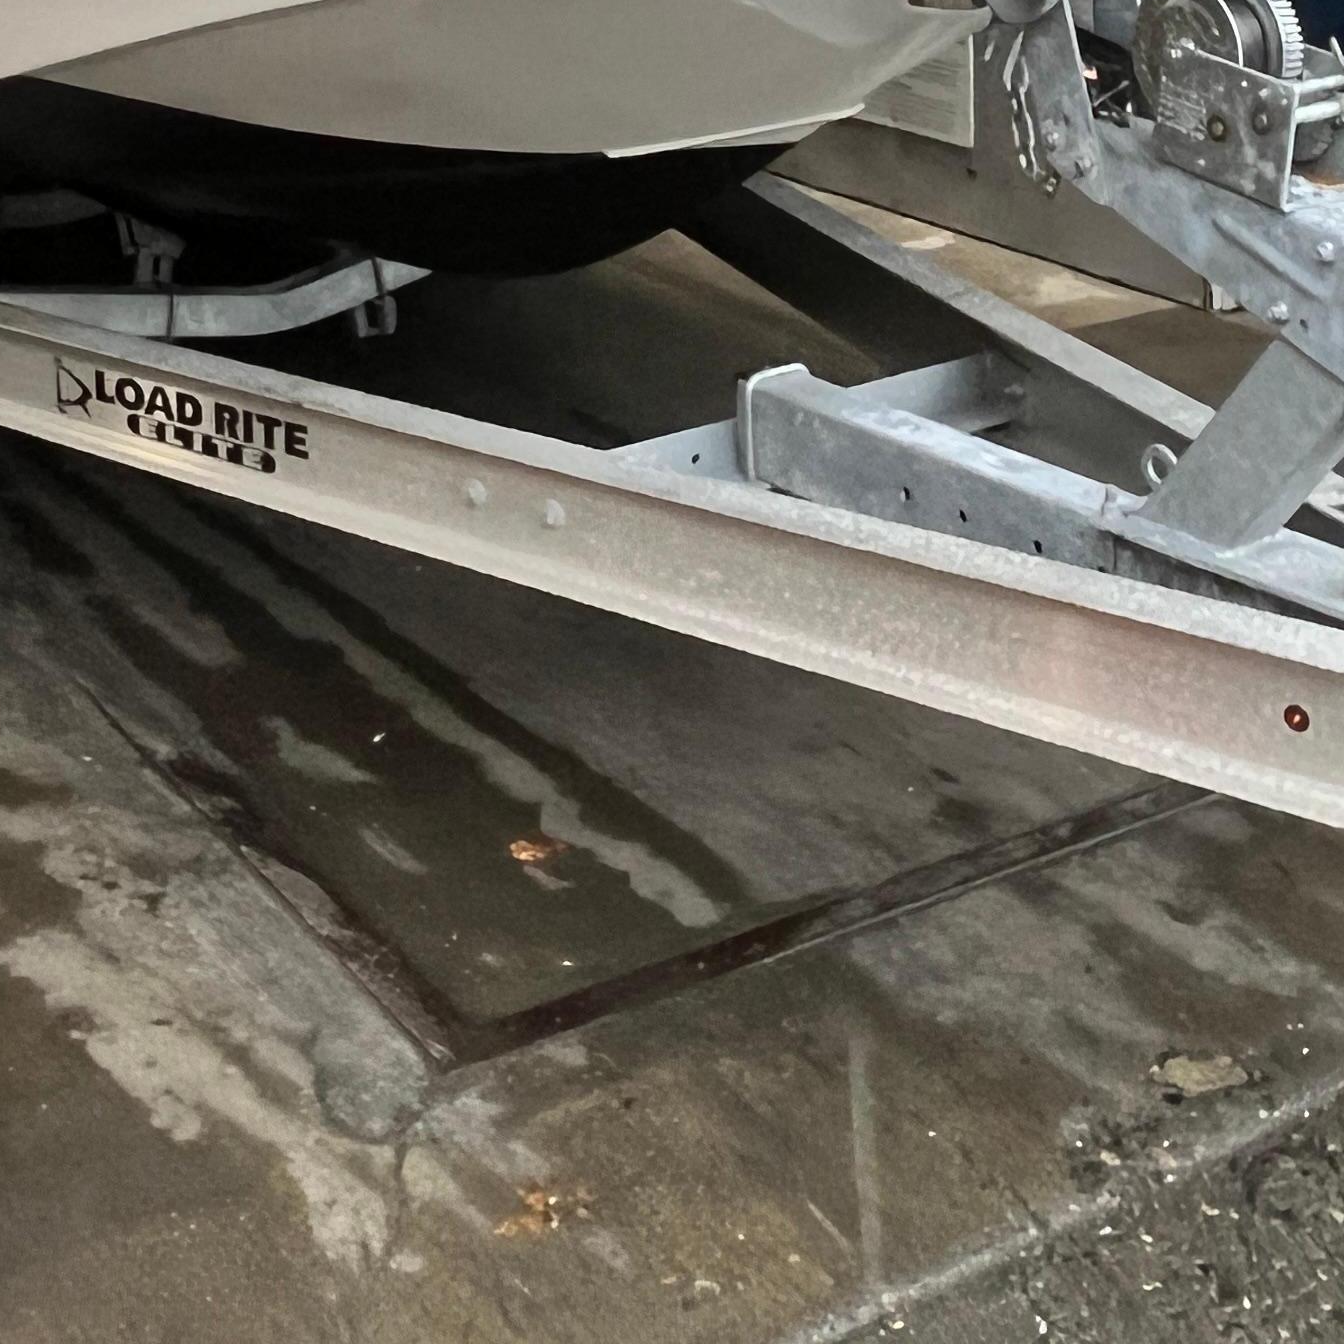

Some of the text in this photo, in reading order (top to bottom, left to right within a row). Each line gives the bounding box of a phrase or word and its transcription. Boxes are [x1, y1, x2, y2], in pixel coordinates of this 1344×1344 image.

[94, 369, 310, 460] LOAD RITE
[136, 416, 266, 469] ELITE
